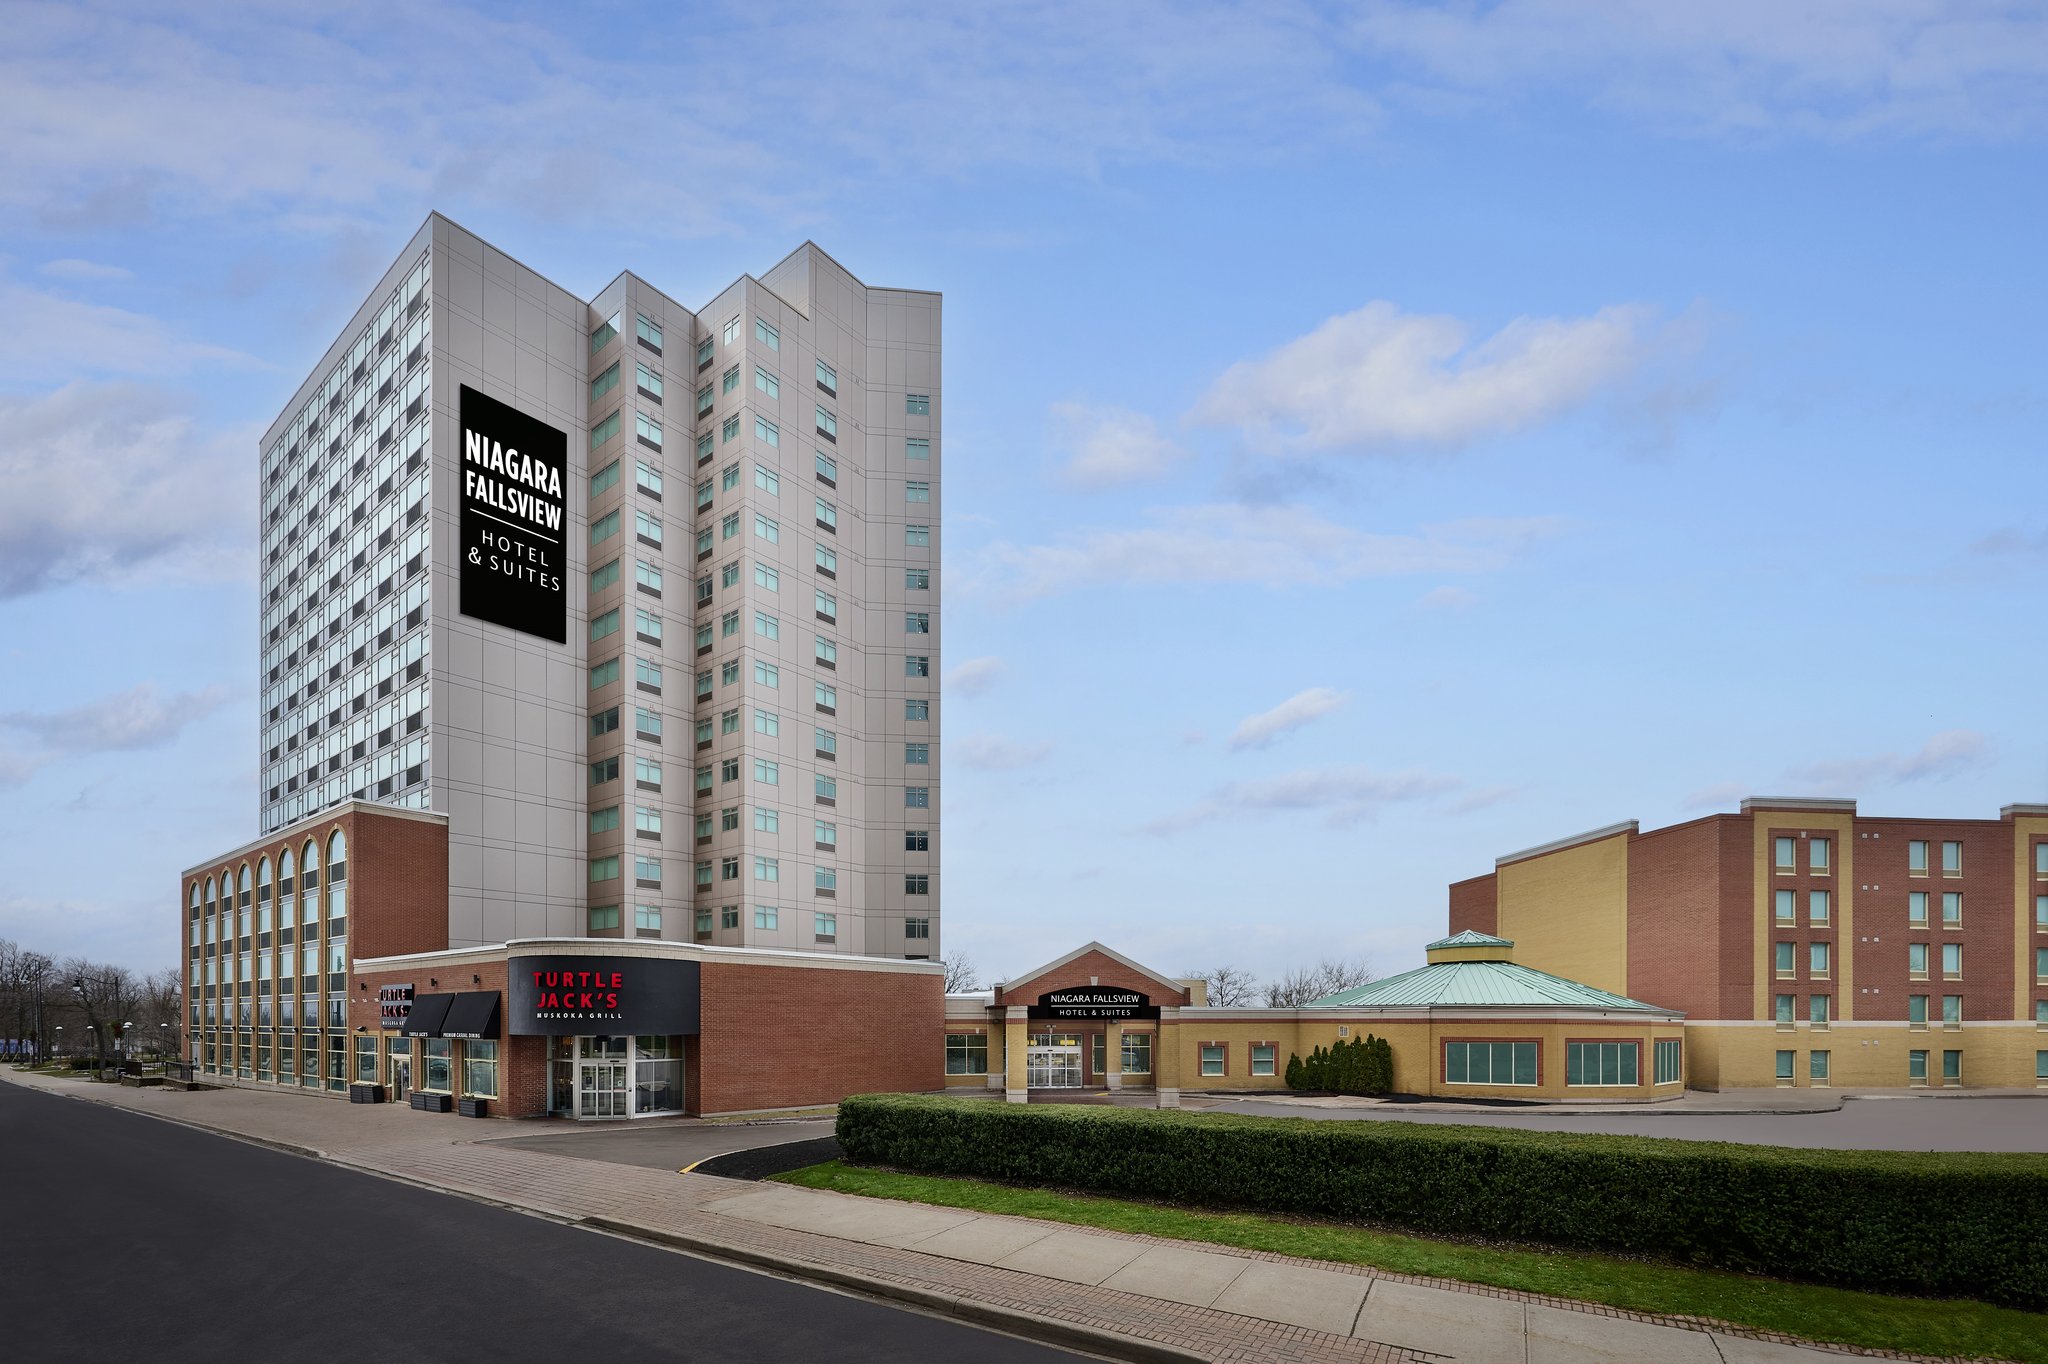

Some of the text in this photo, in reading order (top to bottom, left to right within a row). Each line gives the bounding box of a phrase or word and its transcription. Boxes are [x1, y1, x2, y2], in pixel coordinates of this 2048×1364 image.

[465, 428, 562, 499] NIAGARA
[466, 469, 562, 531] FALLSVIEW
[482, 529, 549, 567] HOTEL
[468, 546, 560, 592] & SUITES
[532, 971, 622, 989] TURTLE
[1050, 994, 1140, 1003] NIAGARA FALLSVIEW
[537, 992, 617, 1009] JACK'S
